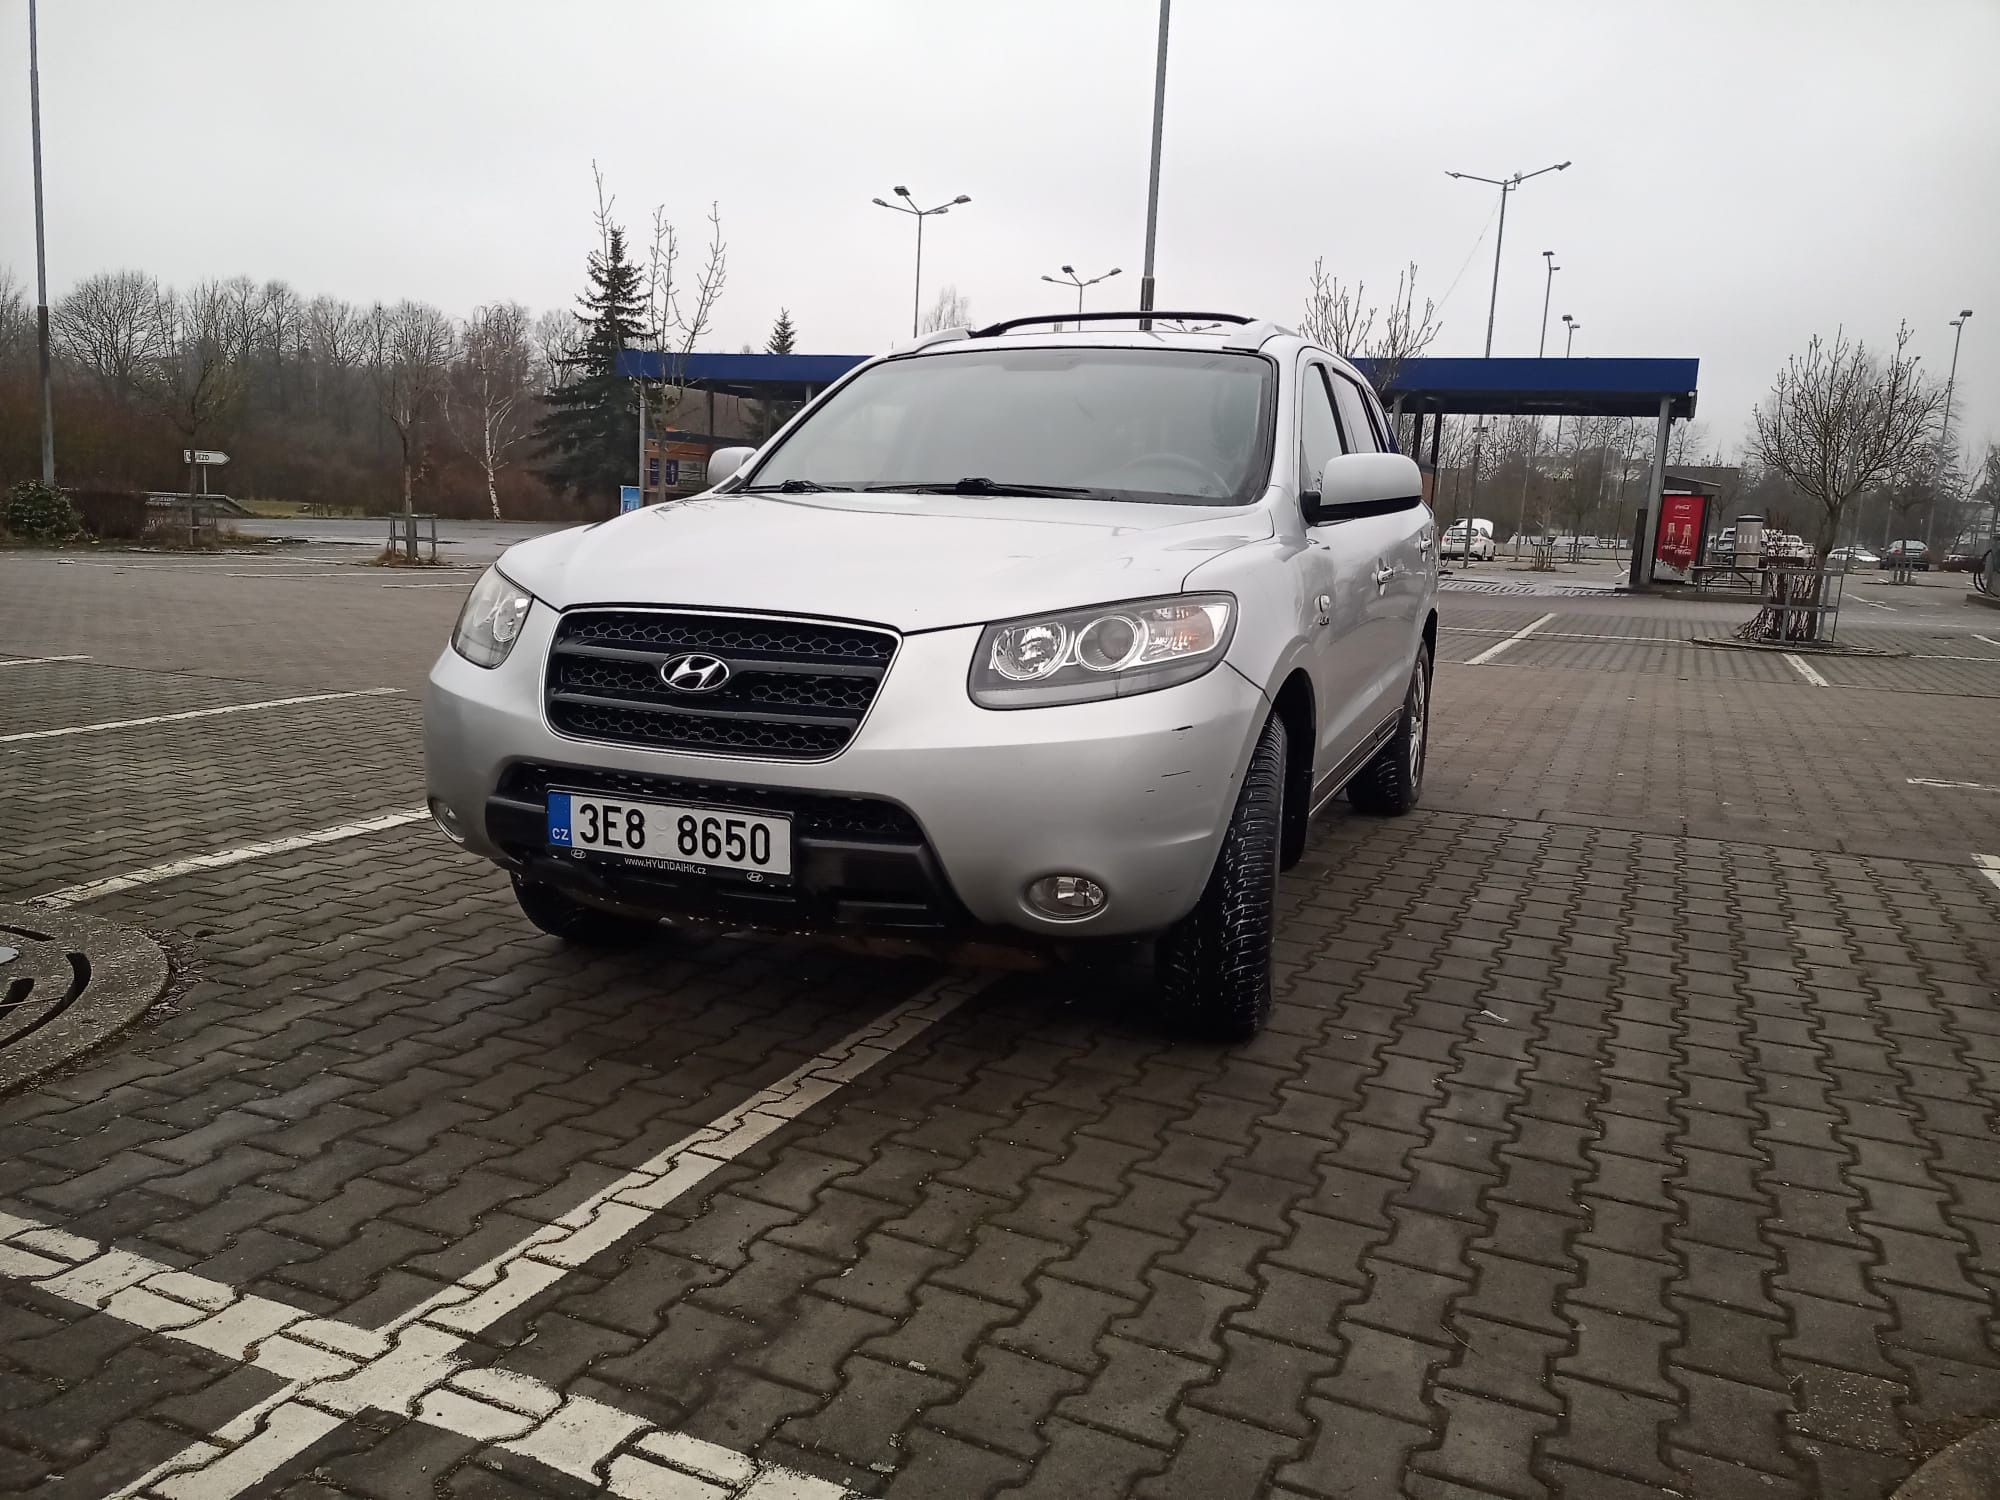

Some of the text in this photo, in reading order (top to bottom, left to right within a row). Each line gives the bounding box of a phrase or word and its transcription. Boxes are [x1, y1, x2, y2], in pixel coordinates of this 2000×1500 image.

[552, 828, 569, 841] CZ
[579, 803, 771, 866] 3E8 8650
